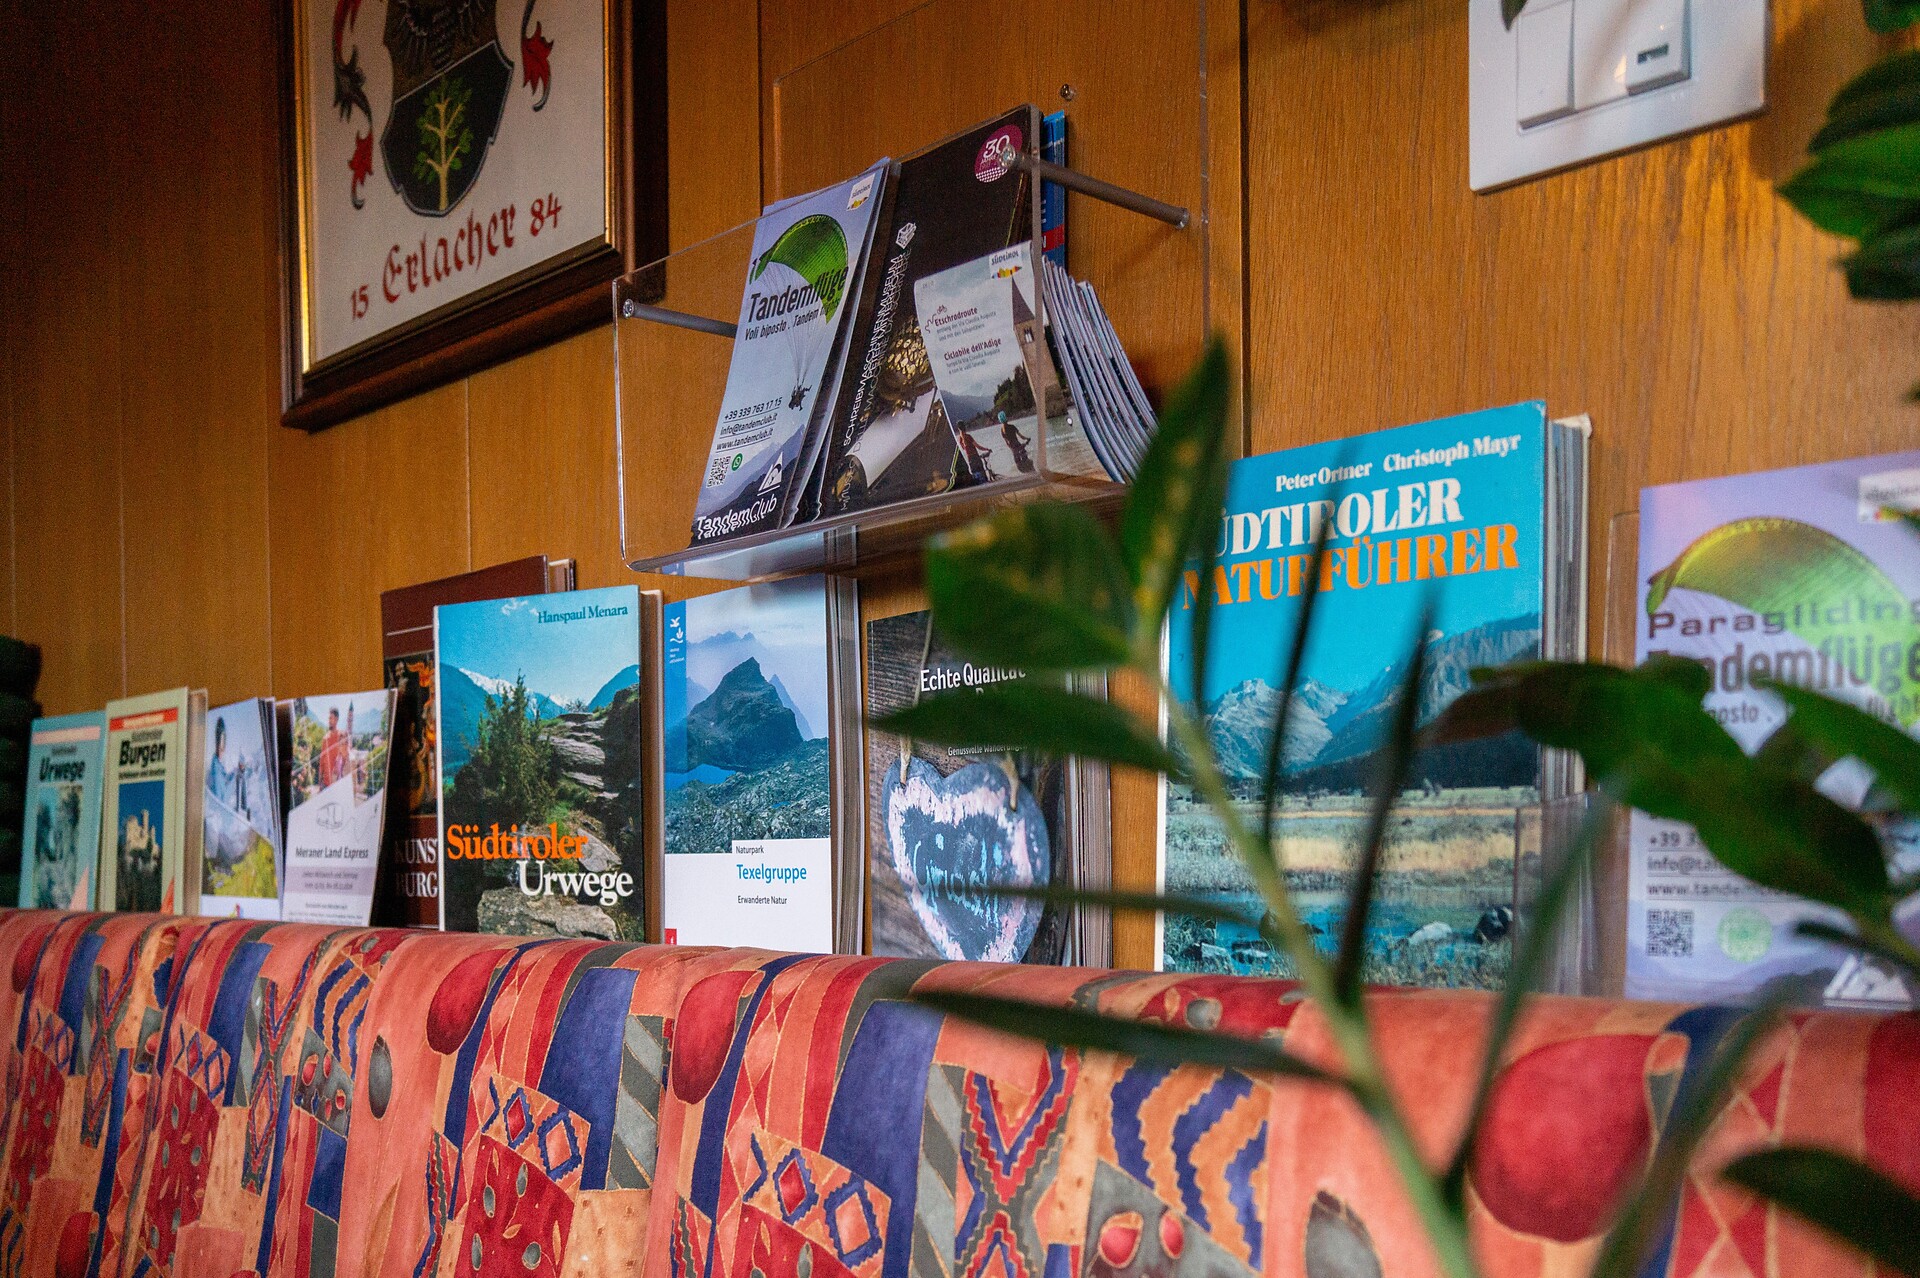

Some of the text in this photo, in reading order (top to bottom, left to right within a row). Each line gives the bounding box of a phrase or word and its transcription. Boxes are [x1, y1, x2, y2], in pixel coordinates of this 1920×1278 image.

[351, 193, 562, 320] 15 Erlacher 84
[748, 266, 849, 323] Tandemflüge
[935, 307, 978, 326] Etschradroute
[745, 326, 759, 341] Voli
[760, 320, 787, 338] biposto
[944, 338, 1001, 361] Ciclabile dell'Adige
[724, 410, 738, 420] +39
[738, 407, 751, 418] 339
[752, 403, 765, 414] 763
[720, 413, 777, 436] info@tandemclub.it
[716, 428, 774, 450] www.tandemclub.it
[1276, 434, 1522, 492] Peter Ortner Christoph Mayr
[697, 493, 777, 540] TandemClub
[1216, 477, 1464, 558] DTIROLER
[538, 605, 629, 625] Hanspaul Menara
[920, 668, 961, 692] Echte
[119, 740, 166, 768] Burgen
[39, 757, 85, 782] Urwege
[447, 821, 589, 861] Südtiroler
[735, 845, 764, 855] Naturpark
[295, 846, 369, 861] Meraner Land Express
[516, 859, 634, 907] Urwege
[736, 863, 807, 884] Texelgruppe
[737, 895, 788, 905] Erwanderte Natur
